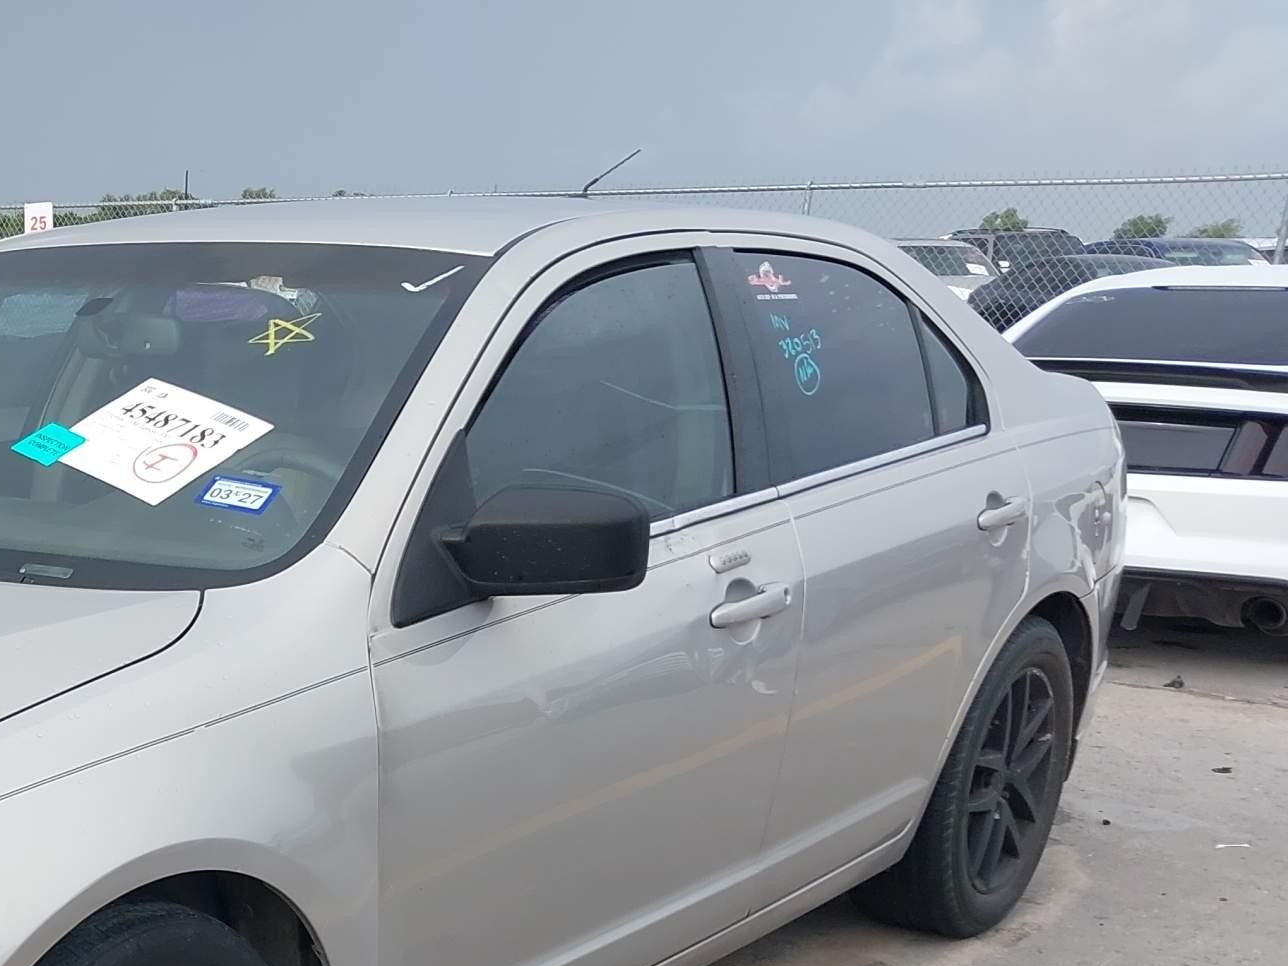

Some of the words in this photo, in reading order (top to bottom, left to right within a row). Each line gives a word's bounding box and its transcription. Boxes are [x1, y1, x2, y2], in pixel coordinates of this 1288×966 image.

[30, 215, 47, 231] 25
[121, 401, 227, 449] 45487183
[209, 487, 232, 500] 03
[237, 492, 264, 505] 27
